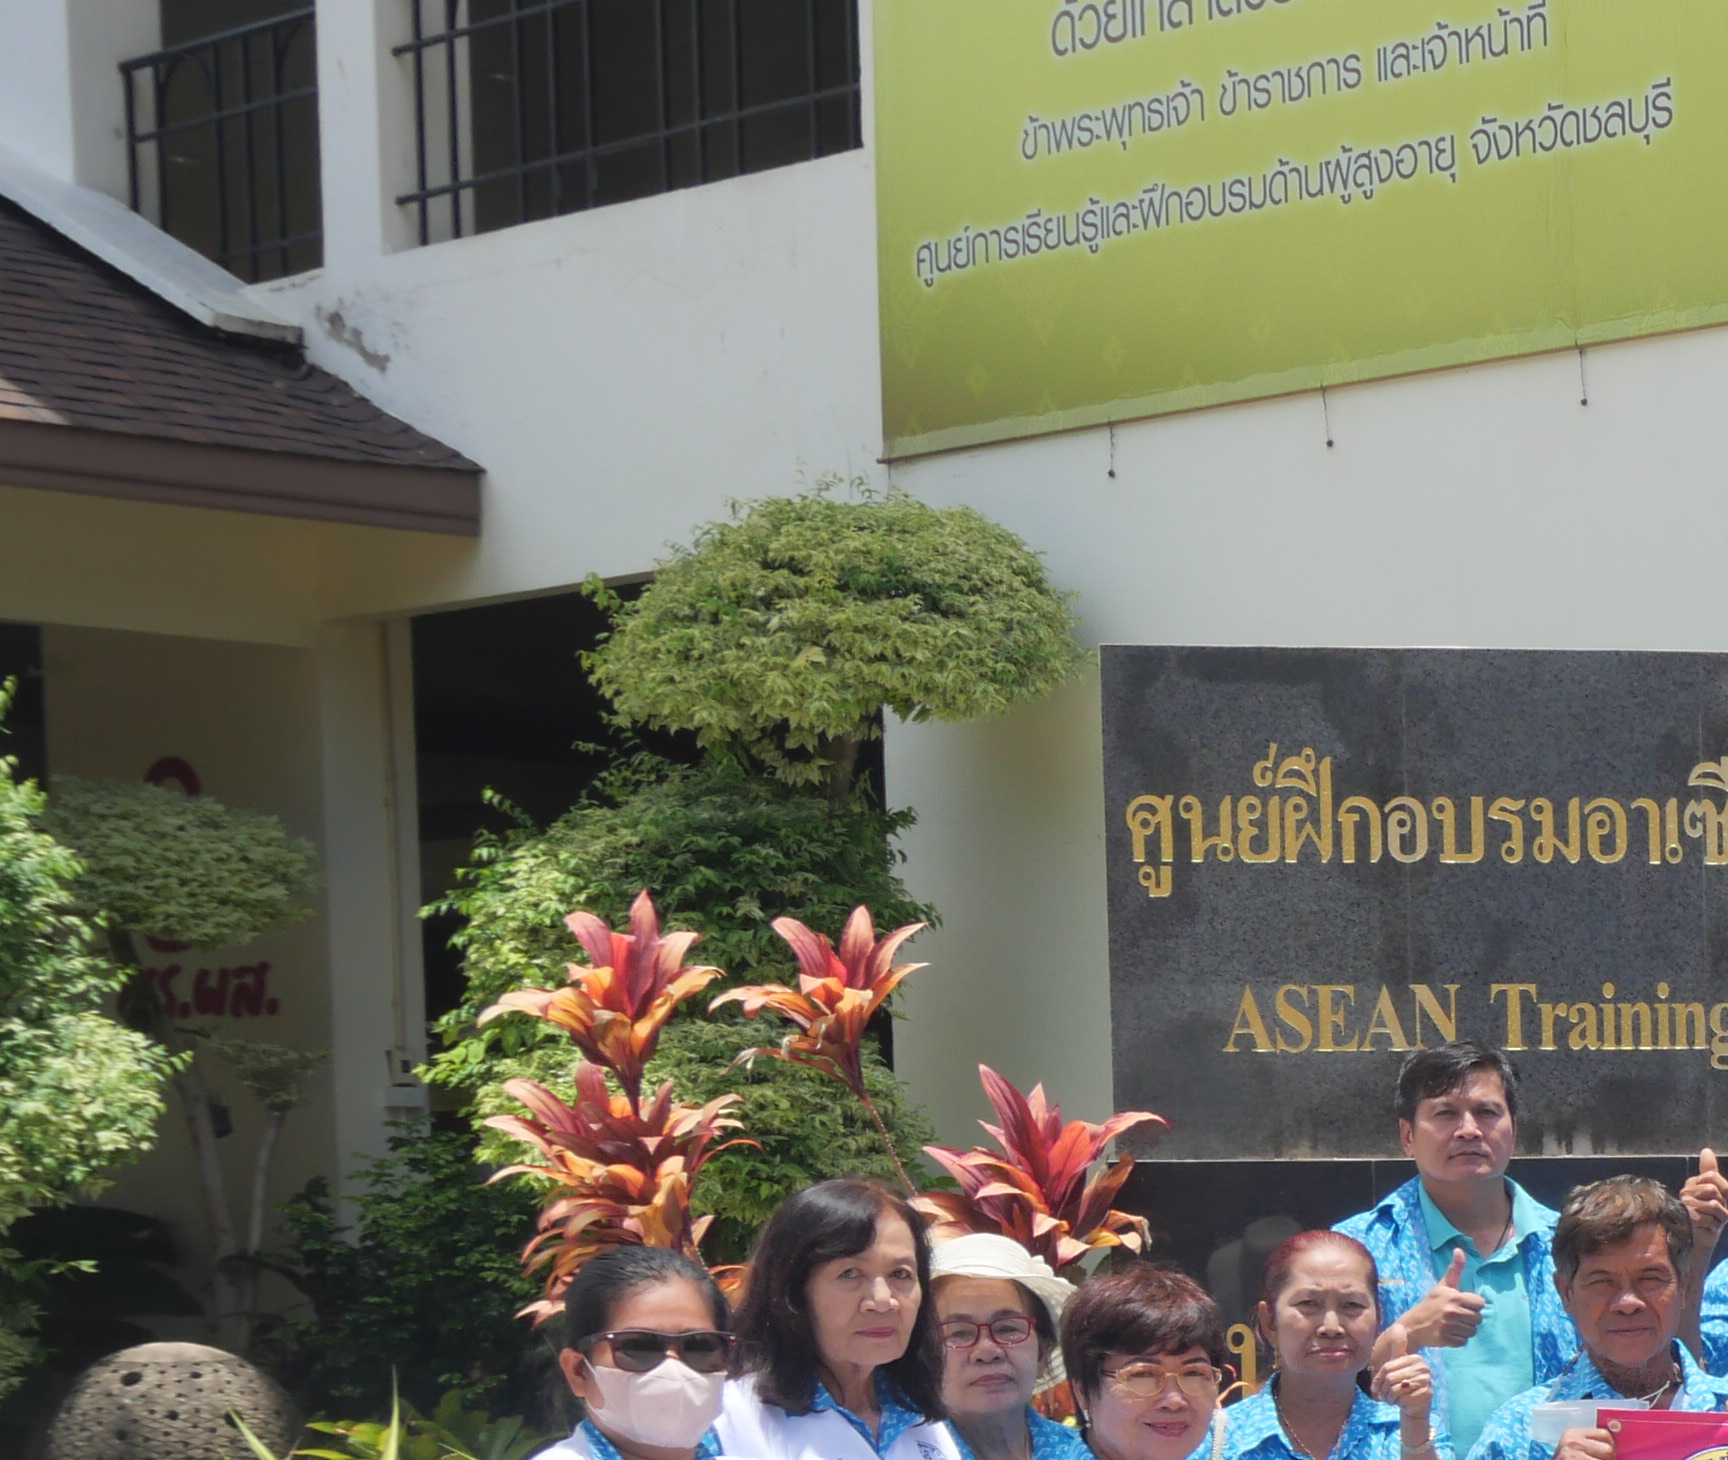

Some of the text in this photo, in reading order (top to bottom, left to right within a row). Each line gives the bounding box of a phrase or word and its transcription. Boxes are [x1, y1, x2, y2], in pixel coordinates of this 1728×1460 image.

[1021, 0, 1548, 161] ข้าพระพุทธเจ้า ข้าราชการ และเจ้าหน้าที
[915, 76, 1675, 288] ศูนย์การเรียนรู้และฝึกอบรมด้านผู้สูงอายุ จังหวัดชลบุรี
[1224, 983, 1460, 1053] ASEAN
